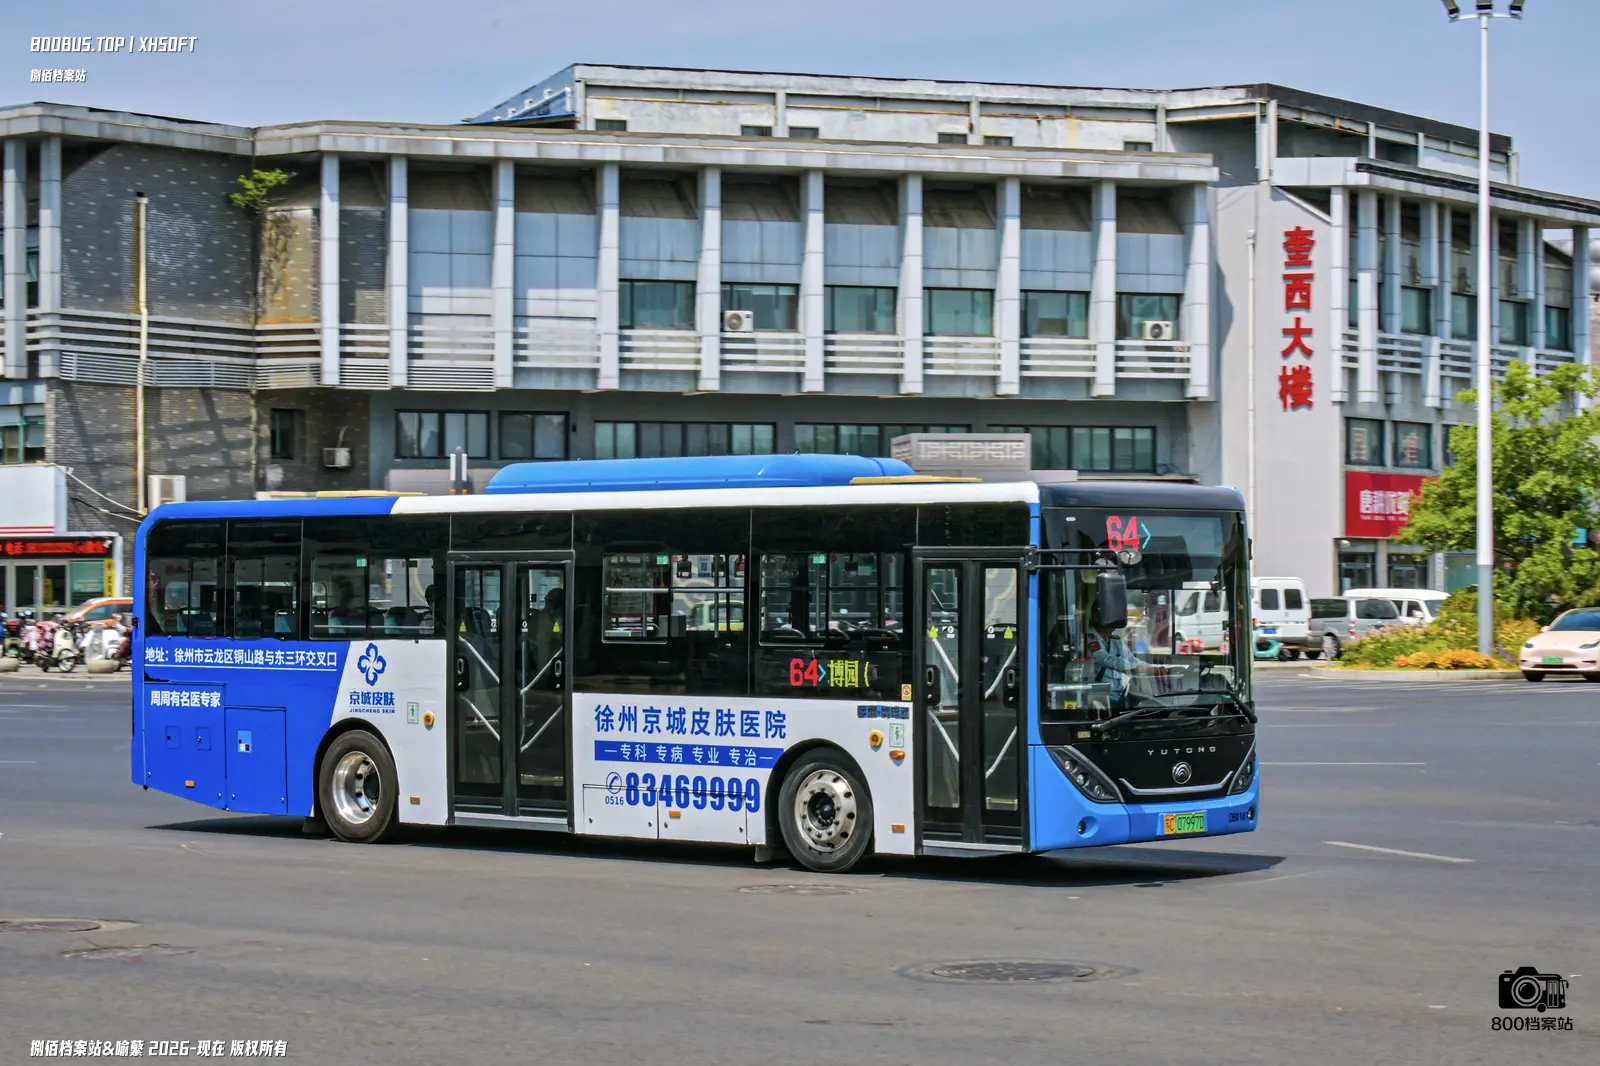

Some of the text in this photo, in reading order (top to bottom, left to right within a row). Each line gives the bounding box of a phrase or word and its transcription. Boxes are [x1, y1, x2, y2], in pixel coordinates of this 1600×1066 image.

[1278, 225, 1316, 411] 奎西大楼
[1106, 515, 1141, 552] 64
[789, 658, 819, 687] 64
[150, 690, 221, 708] 周周有名医专家
[349, 691, 396, 706] 京城皮肤
[594, 704, 787, 740] 徐州京城皮肤医院
[620, 743, 757, 767] 专科 专病 专业 专治
[1147, 746, 1217, 756] YUTONG
[605, 795, 625, 806] 0516
[625, 772, 761, 813] 83469999
